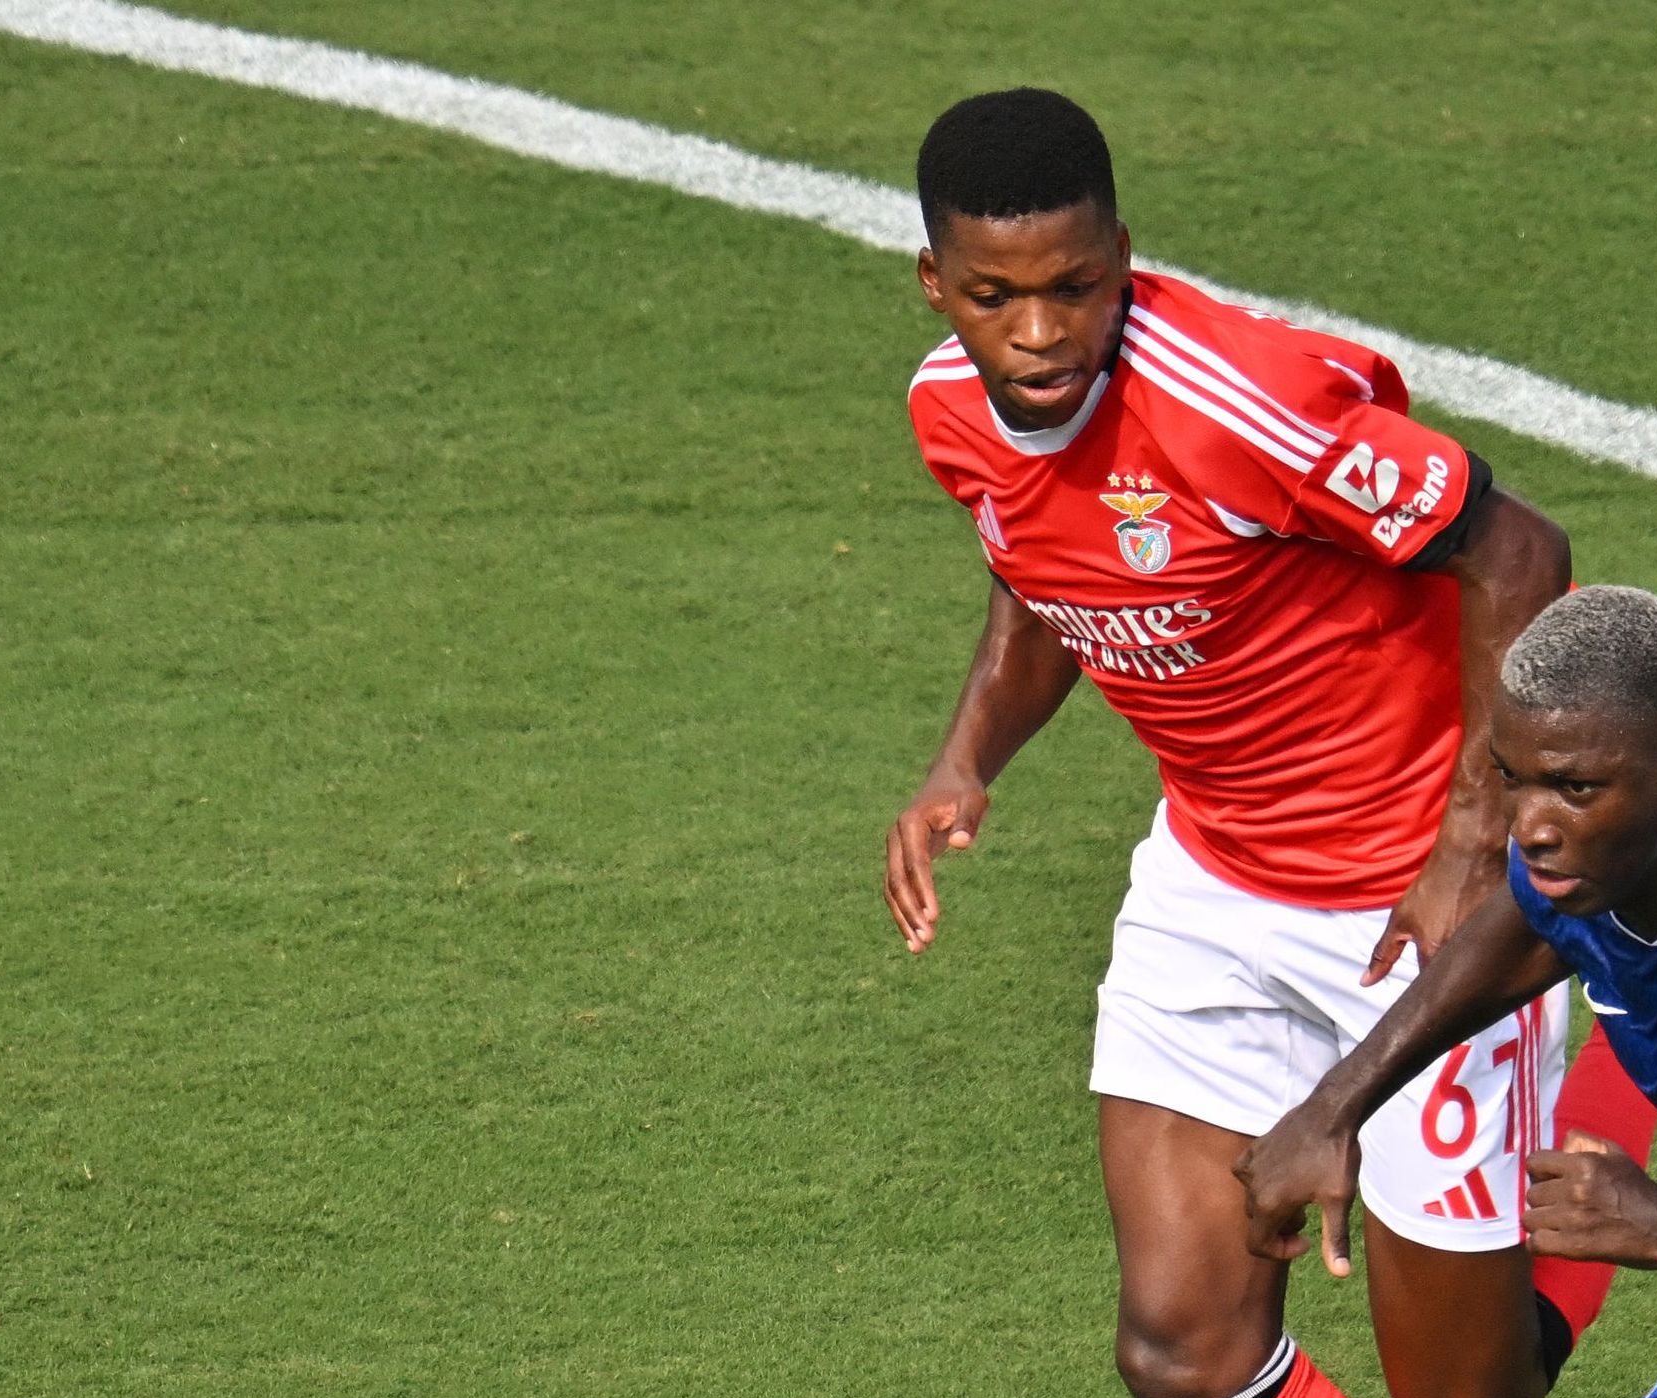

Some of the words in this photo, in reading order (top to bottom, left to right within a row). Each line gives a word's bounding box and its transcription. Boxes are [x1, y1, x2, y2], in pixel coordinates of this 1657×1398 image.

[1370, 455, 1448, 549] Betano
[1023, 598, 1212, 646] mirates
[1421, 1037, 1520, 1159] 67
